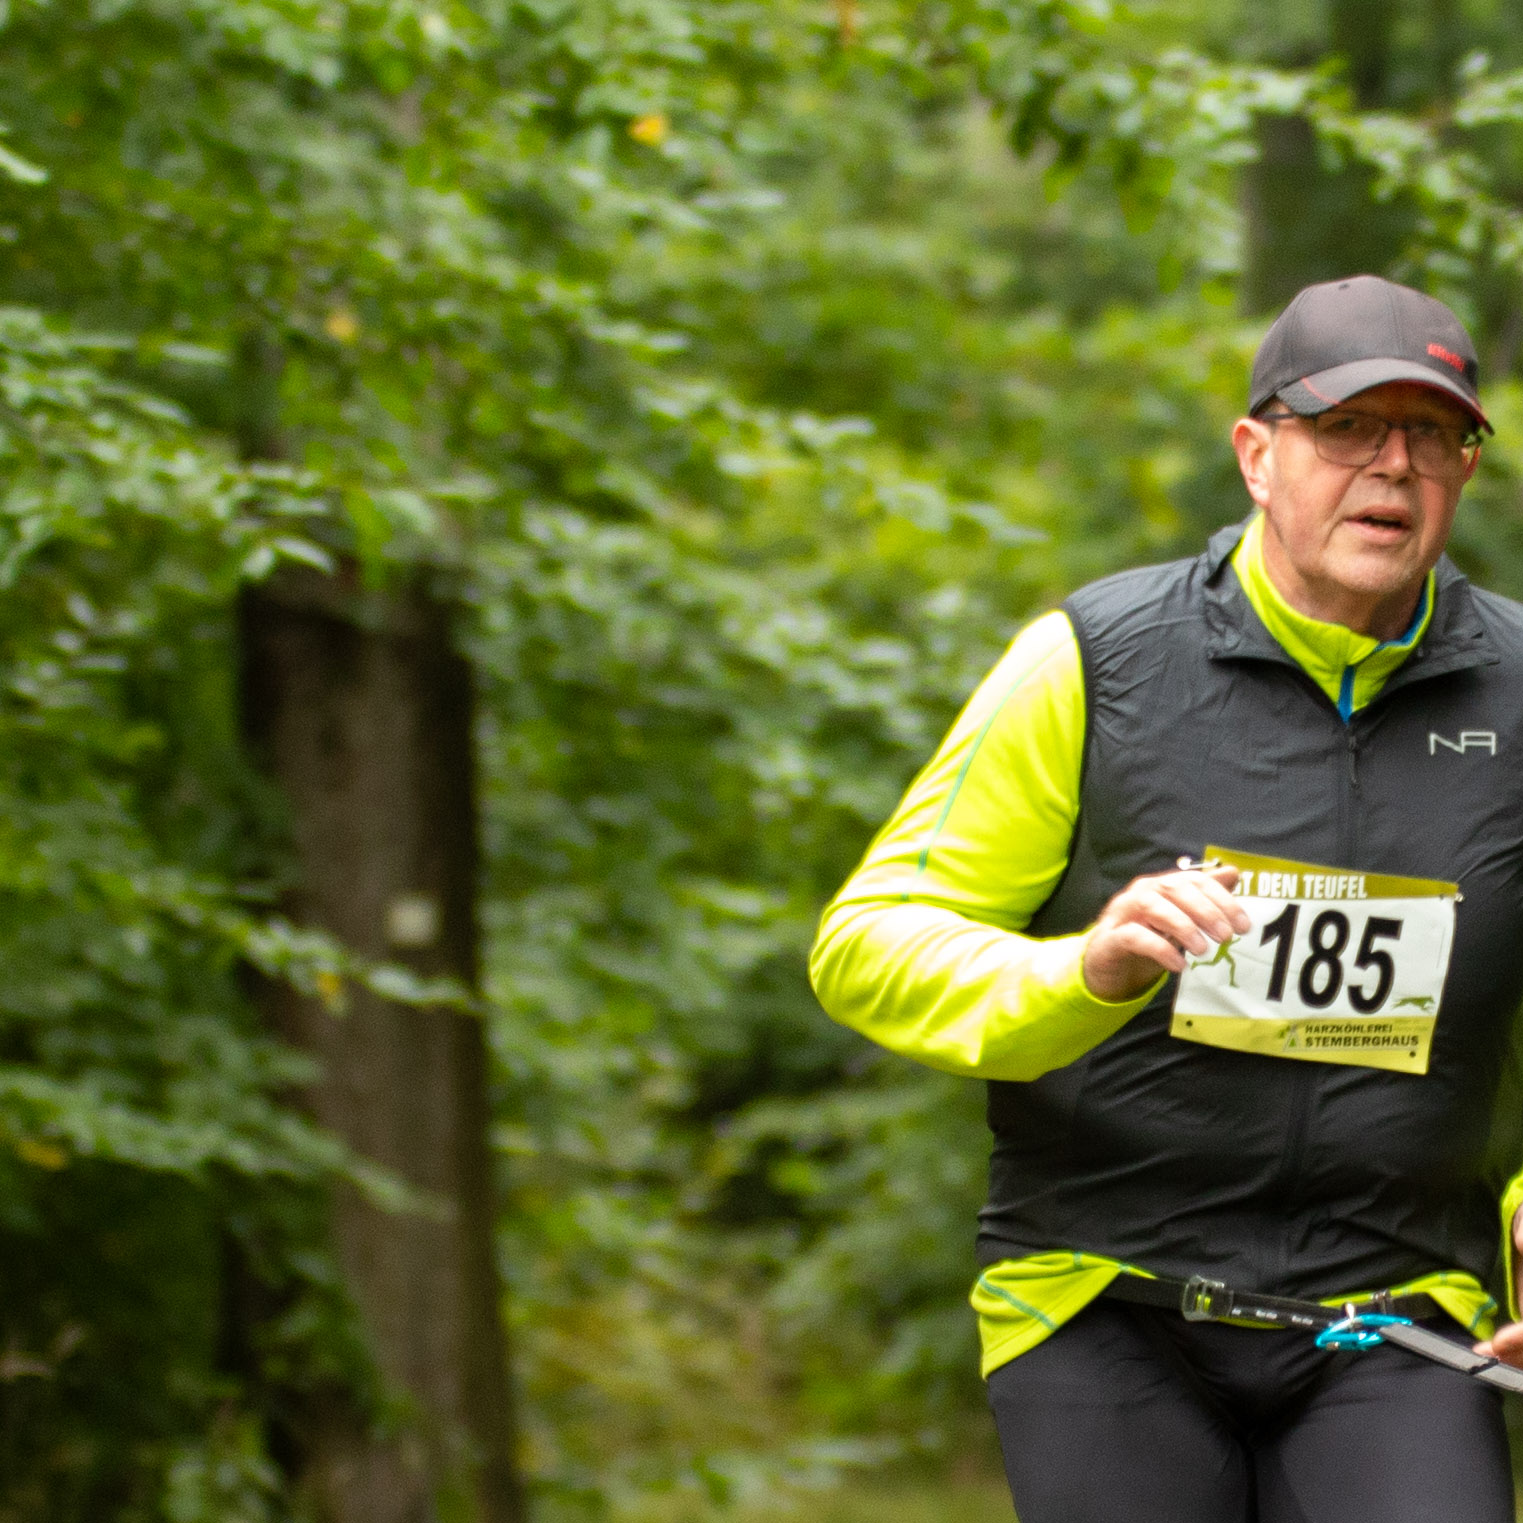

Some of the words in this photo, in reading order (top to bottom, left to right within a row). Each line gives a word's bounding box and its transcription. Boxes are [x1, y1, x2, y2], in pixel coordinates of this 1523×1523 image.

[1257, 871, 1298, 898] DEN
[1303, 873, 1368, 900] TEUFEL
[1259, 903, 1404, 1015] 185
[1305, 1023, 1392, 1034] HARZKÖHLEREI
[1305, 1035, 1419, 1048] STEMBERGHAUS
